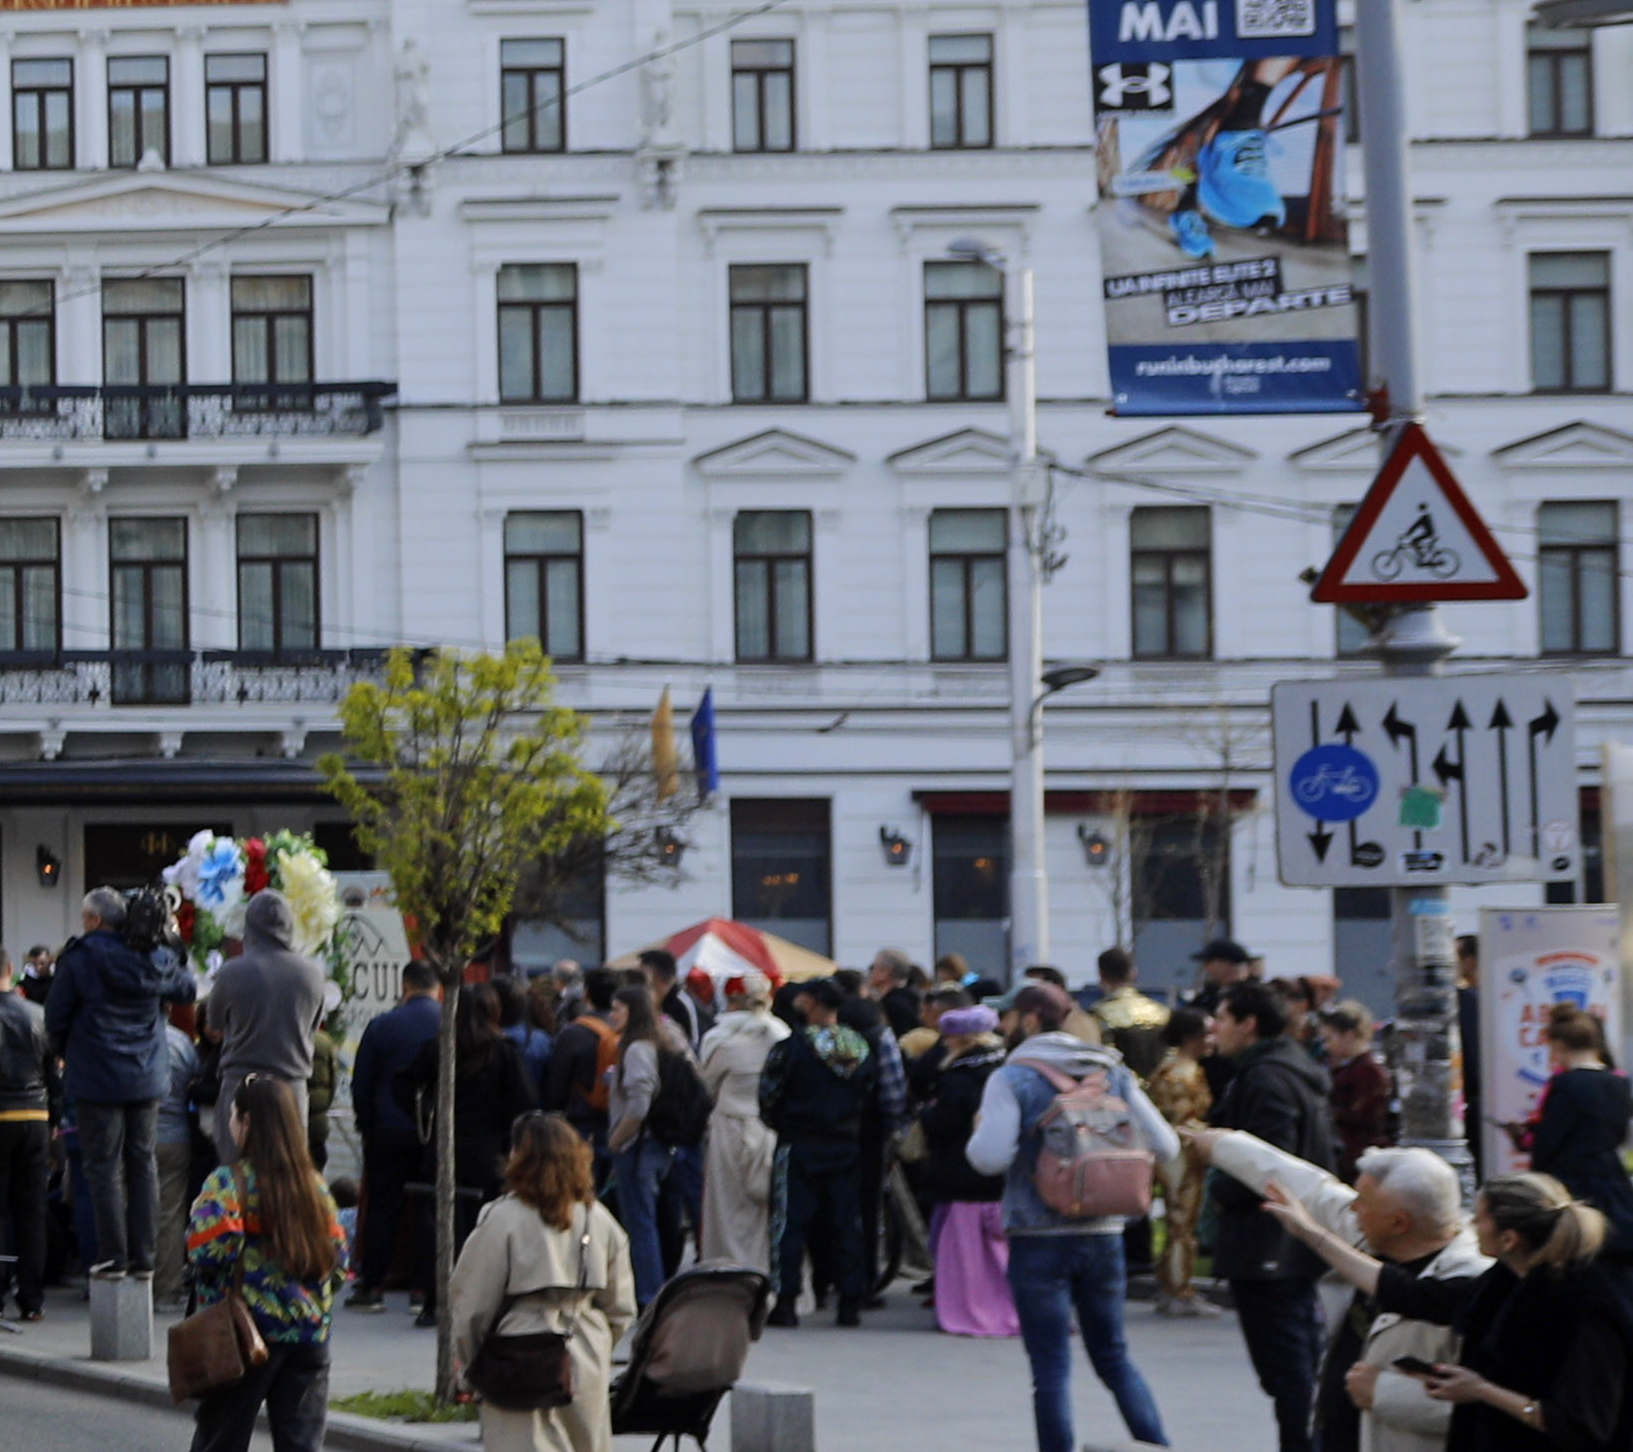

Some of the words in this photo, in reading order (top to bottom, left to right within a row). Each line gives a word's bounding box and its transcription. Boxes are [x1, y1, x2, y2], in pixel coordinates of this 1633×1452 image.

[1118, 0, 1218, 42] MAI
[1108, 278, 1136, 295] UA
[1140, 268, 1211, 291] INFINITE
[1213, 260, 1261, 284] ELITE
[1262, 258, 1276, 276] 2
[1243, 280, 1275, 297] MAI
[1167, 287, 1351, 325] DEPARTE
[1136, 354, 1331, 376] runinbucharest.com
